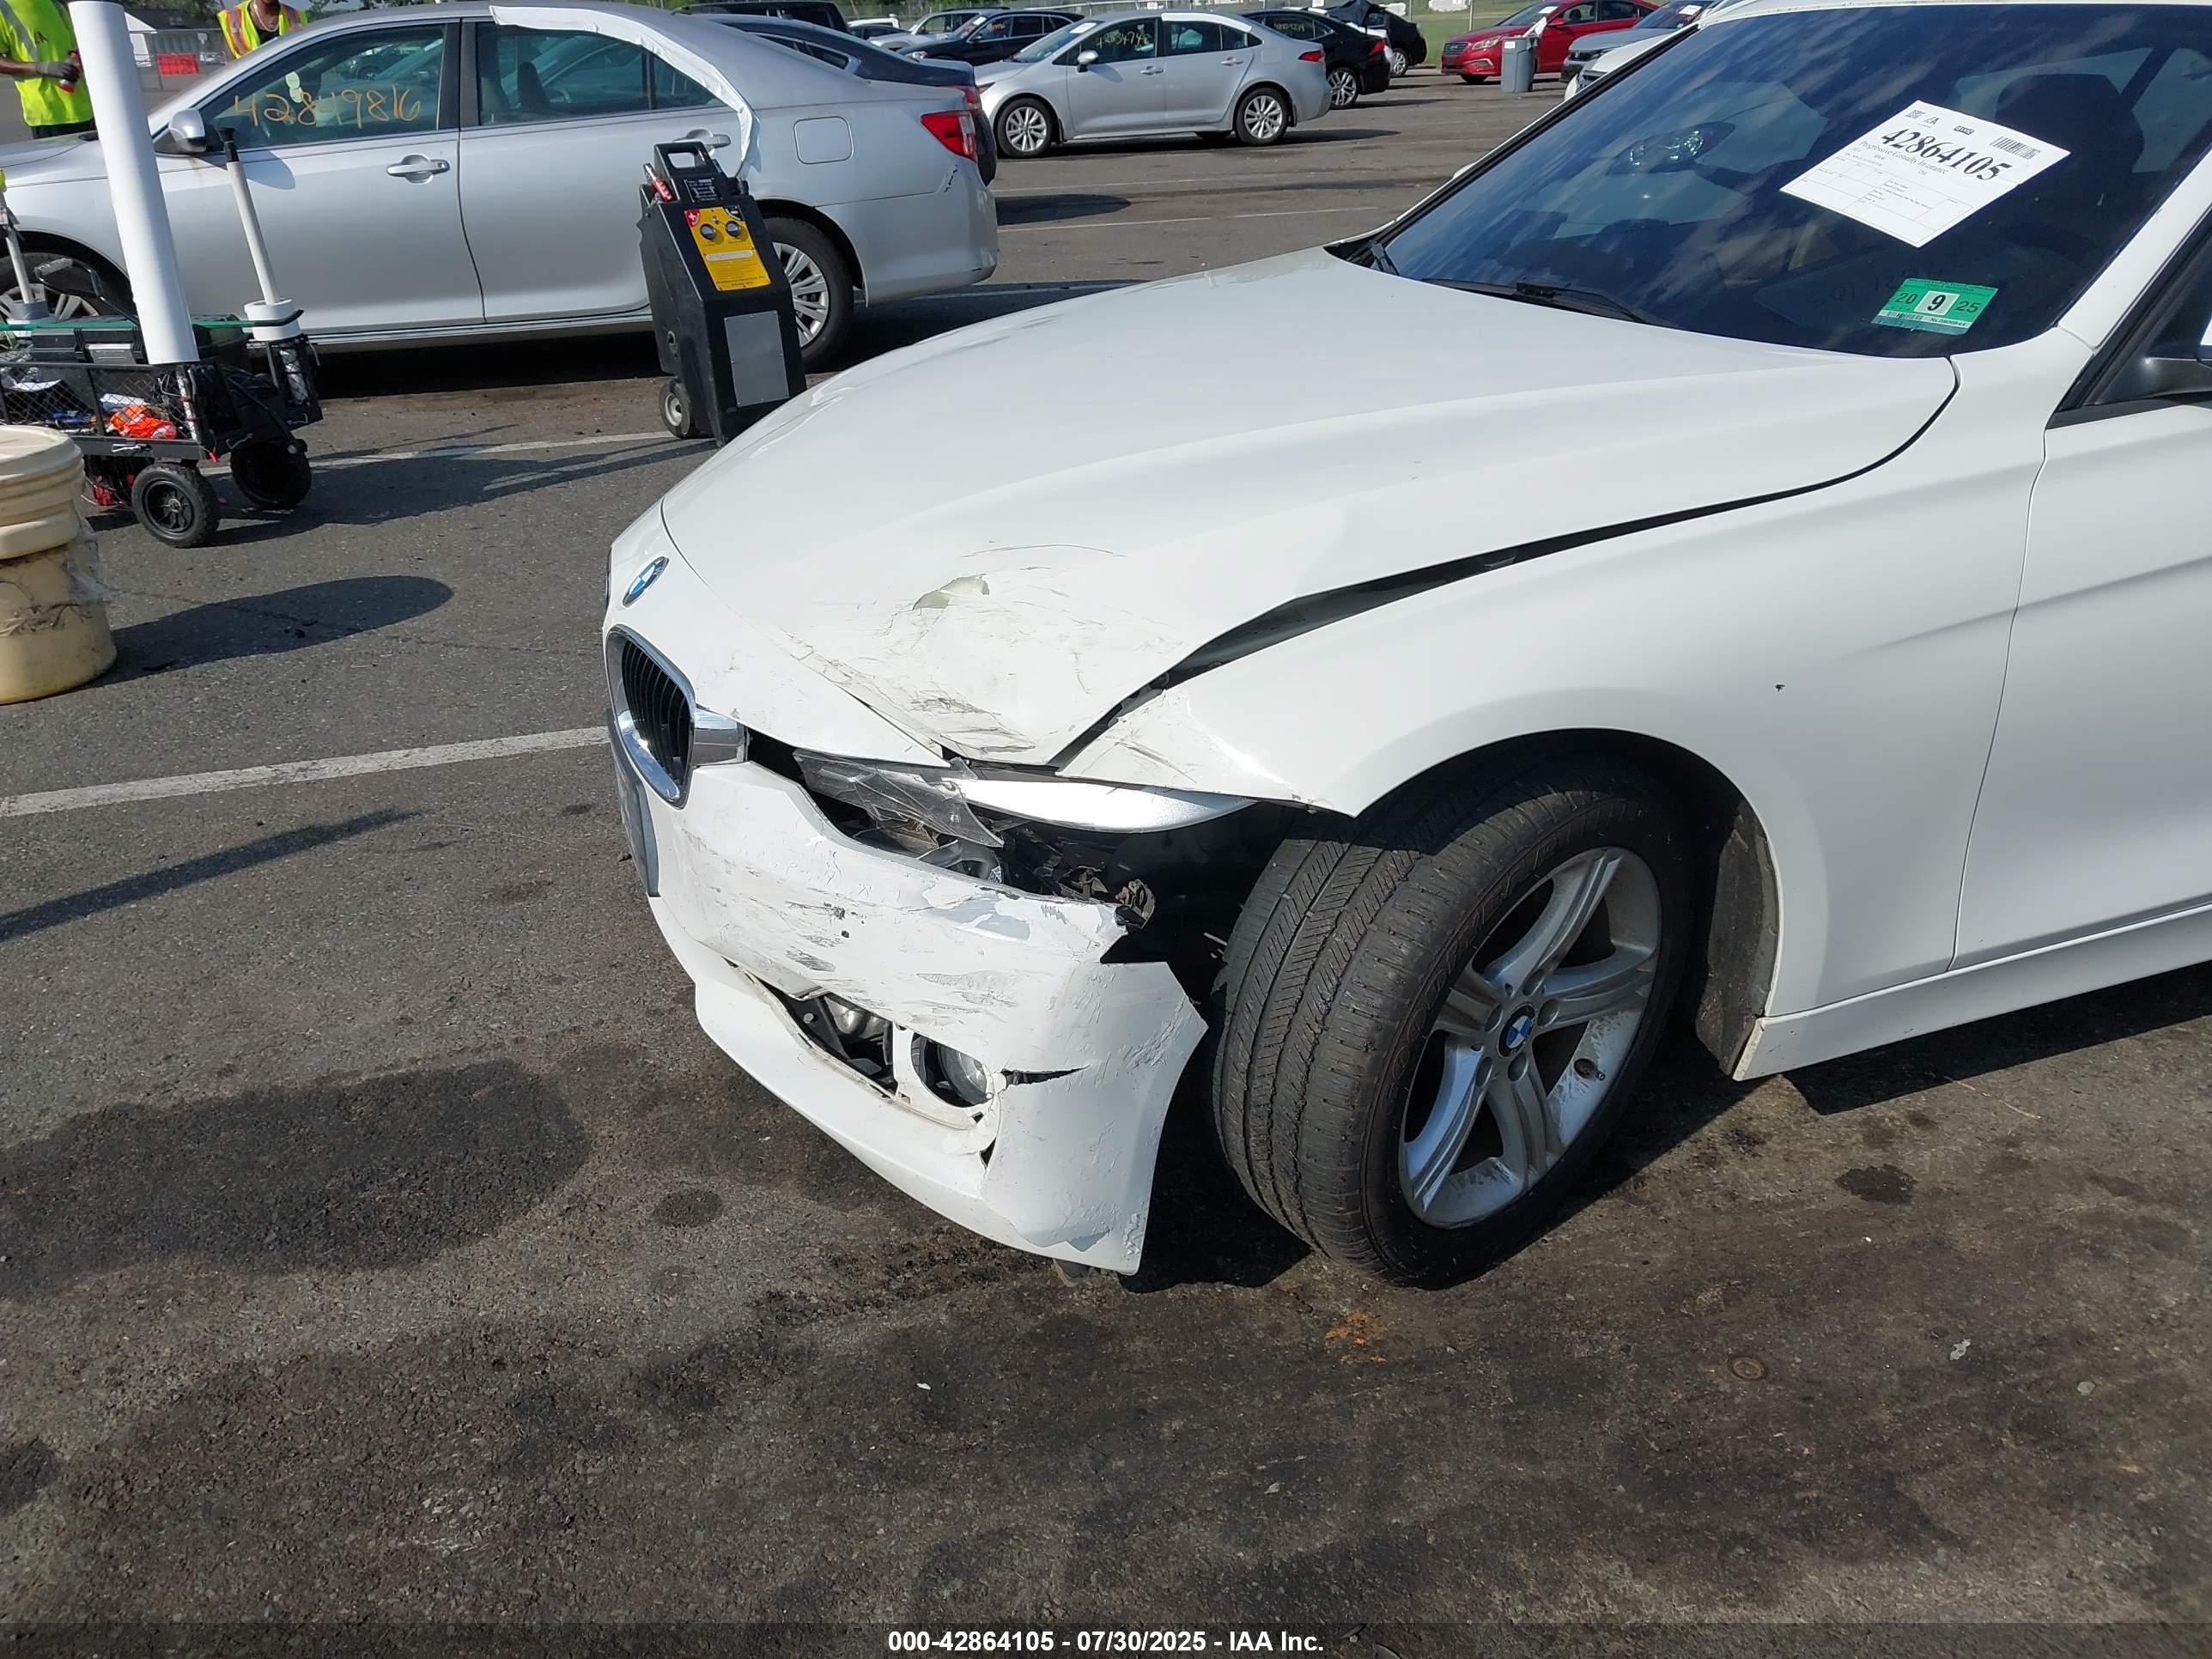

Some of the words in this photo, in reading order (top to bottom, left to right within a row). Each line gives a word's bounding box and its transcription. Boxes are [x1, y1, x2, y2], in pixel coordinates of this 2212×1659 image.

[234, 82, 421, 128] 42849816
[1859, 141, 1893, 155] Progressive
[1881, 129, 2013, 180] 42864105
[1895, 292, 1917, 305] 20
[1927, 294, 1946, 311] 9
[1955, 301, 1981, 313] 25
